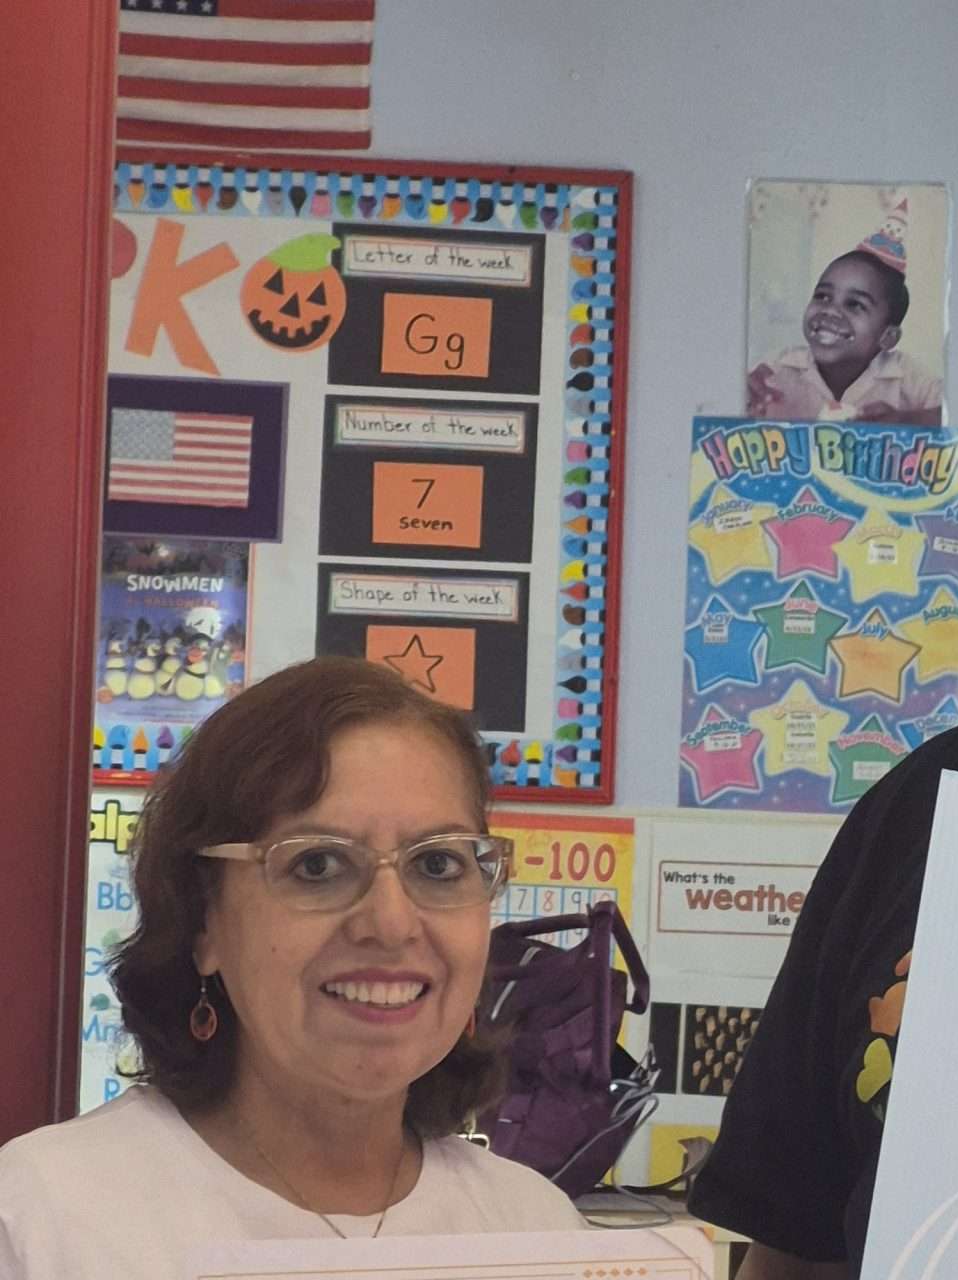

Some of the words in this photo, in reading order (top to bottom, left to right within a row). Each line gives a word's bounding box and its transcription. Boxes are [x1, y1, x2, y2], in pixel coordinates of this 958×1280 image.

[352, 240, 413, 264] Letter
[424, 244, 440, 266] of
[449, 246, 473, 268] the
[477, 250, 514, 270] week
[405, 313, 466, 371] Gg
[344, 410, 412, 434] Number
[422, 415, 436, 432] of
[447, 418, 476, 437] the
[482, 422, 519, 438] week
[701, 424, 812, 480] Happy
[411, 478, 436, 510] 7
[399, 516, 454, 531] seven
[126, 574, 225, 593] SNOWMEN
[340, 580, 395, 605] Shape
[402, 582, 419, 602] of
[428, 586, 459, 604] the
[463, 590, 504, 606] week
[663, 871, 709, 884] What's
[713, 873, 736, 885] the
[97, 881, 134, 912] Bb
[516, 888, 528, 912] 7
[543, 889, 555, 912] 8
[768, 914, 791, 926] like
